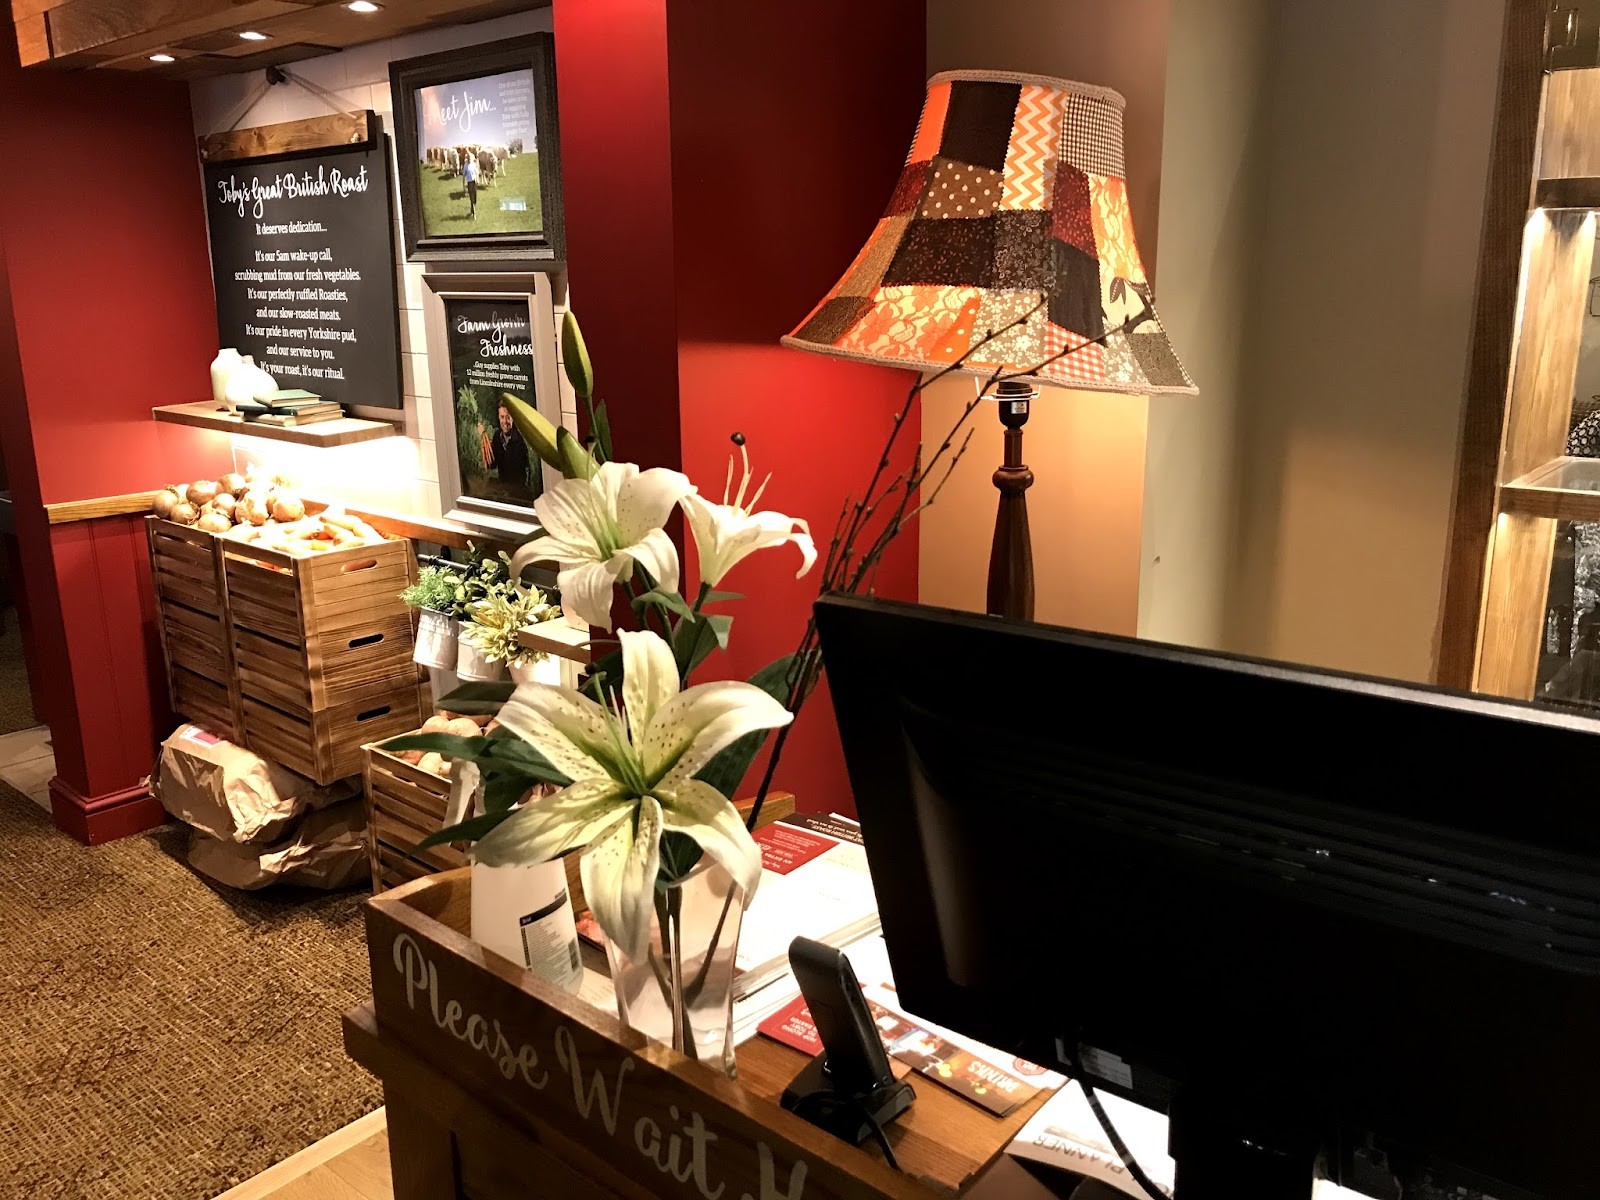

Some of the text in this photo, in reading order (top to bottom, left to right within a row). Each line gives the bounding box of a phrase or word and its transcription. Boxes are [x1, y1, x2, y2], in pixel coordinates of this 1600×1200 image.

[217, 165, 368, 219] Toby's Great British Roast
[256, 220, 327, 235] It deserves dedication...
[255, 248, 332, 263] It's our 5am wake-up call,
[234, 268, 361, 283] scrubbing mud from our fresh vegetables.
[247, 287, 348, 302] It's our perfectly ruffled Roasties,
[256, 307, 341, 321] and our slow-roasted meats.
[245, 324, 357, 343] It's our pride in every Yorkshire pud,
[457, 315, 490, 334] Farm
[266, 344, 335, 361] and our service to you.
[480, 334, 533, 357] Freshness
[260, 361, 344, 379] It's your roast, it's our ritual.
[392, 932, 549, 1090] Please
[554, 1025, 726, 1200] Wait
[967, 1061, 1021, 1093] DRINKS
[1033, 1135, 1125, 1174] PLANNER
